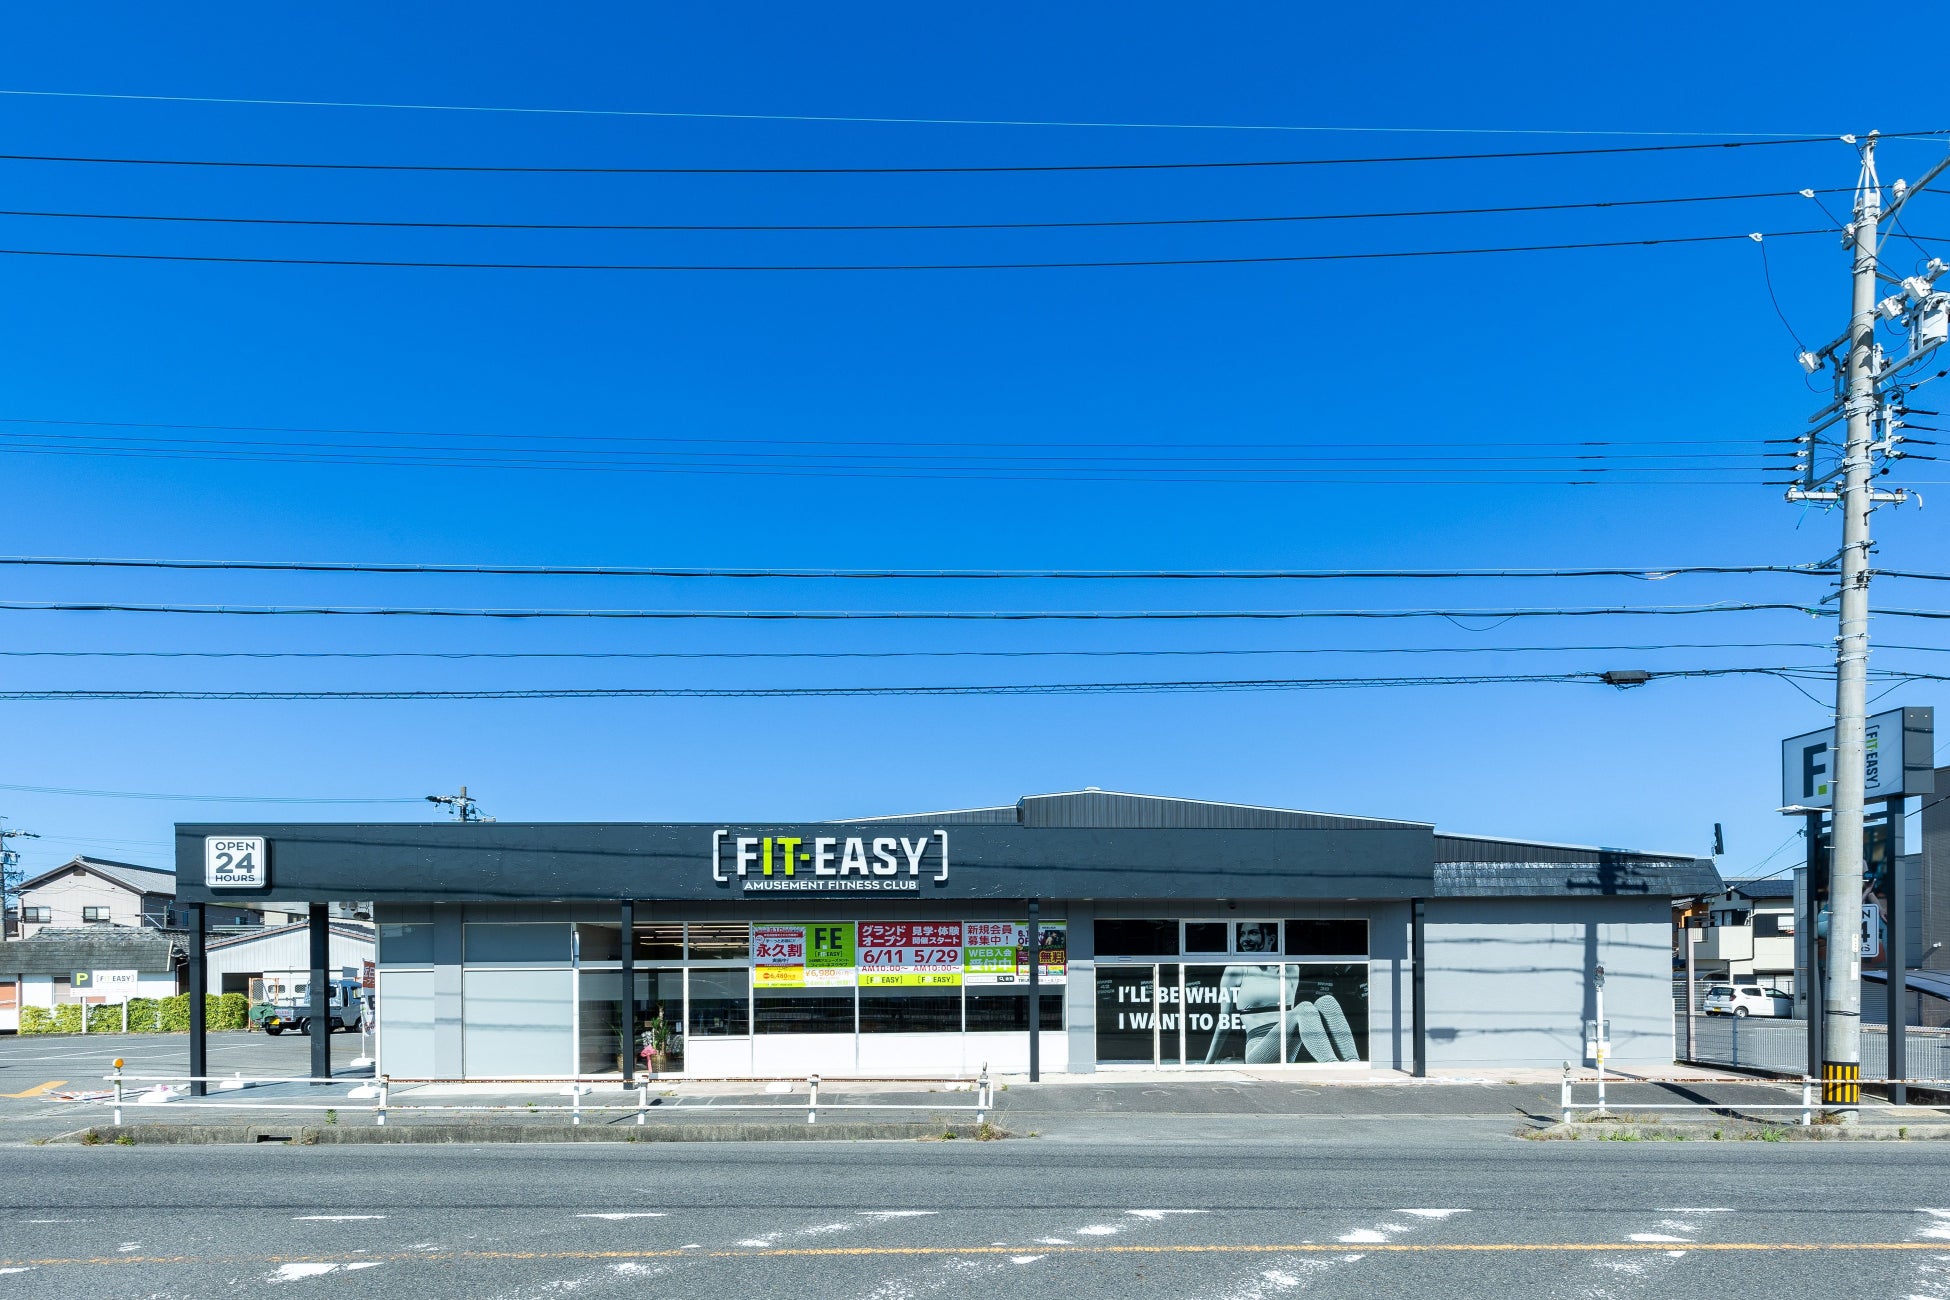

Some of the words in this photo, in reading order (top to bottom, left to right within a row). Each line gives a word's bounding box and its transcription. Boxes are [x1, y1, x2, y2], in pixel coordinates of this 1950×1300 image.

[215, 841, 255, 851] OPEN
[215, 852, 255, 874] 24
[215, 874, 255, 882] HOURS
[744, 880, 824, 890] AMUSEMENT
[828, 880, 880, 890] FITNESS
[883, 880, 917, 890] CLUB
[862, 925, 906, 936] グランド
[912, 926, 960, 936] 見学・体験
[967, 924, 1012, 935] 新規会員
[862, 936, 907, 946] オープン
[912, 936, 960, 945] 開催スタート
[756, 944, 802, 957] 永久割
[863, 949, 903, 963] 6/11
[914, 949, 958, 963] 5/29
[968, 948, 1012, 957] WEB入会
[969, 958, 1012, 971] 受付中
[76, 972, 89, 986] P
[1159, 986, 1179, 1003] BE
[1185, 987, 1240, 1004] WHAT
[1118, 1013, 1124, 1030] I
[1129, 1013, 1180, 1030] WANT
[1189, 1014, 1214, 1030] TO
